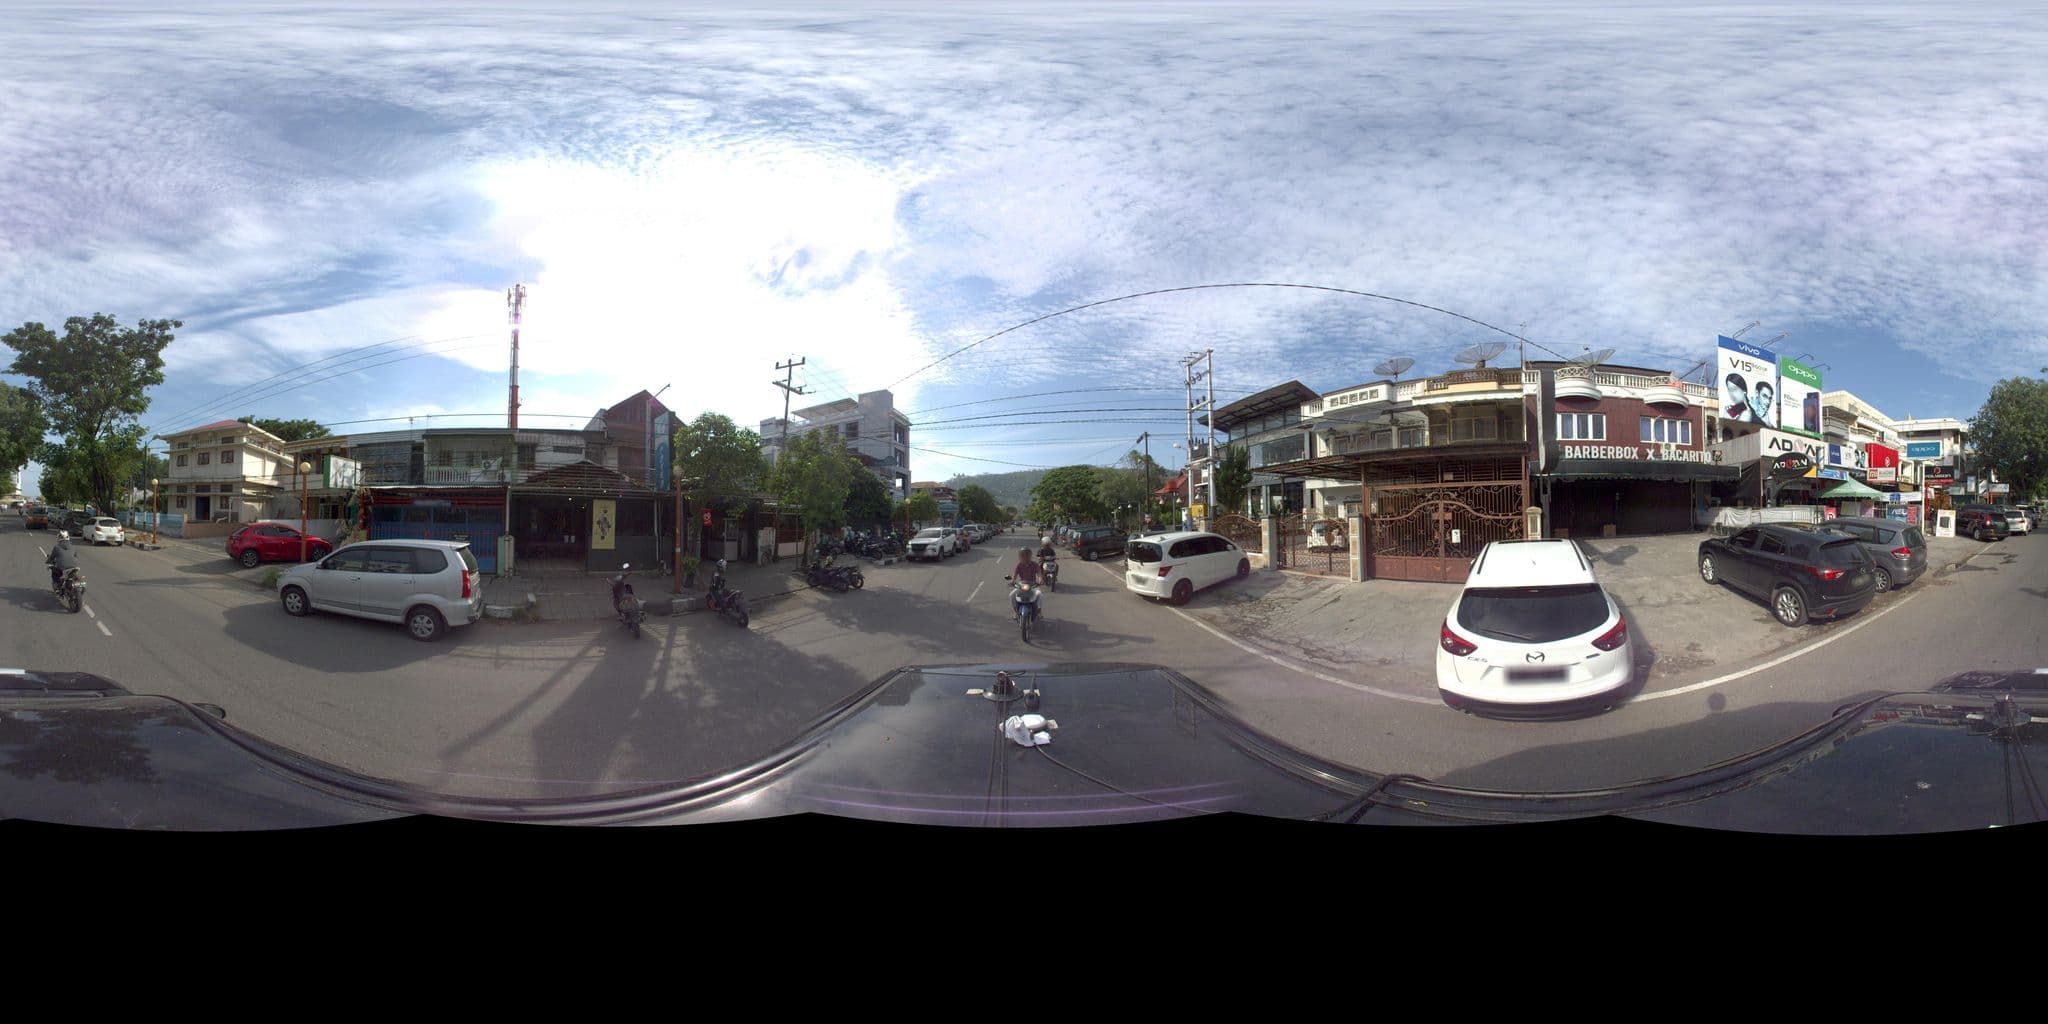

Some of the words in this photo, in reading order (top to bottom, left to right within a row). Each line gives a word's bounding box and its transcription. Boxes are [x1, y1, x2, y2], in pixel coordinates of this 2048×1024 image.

[1738, 344, 1760, 356] vivo
[1729, 356, 1752, 373] V15
[1788, 364, 1817, 380] oppo
[1564, 445, 1639, 460] BARBERBOX
[1661, 449, 1712, 463] BACARITO
[1768, 437, 1816, 457] ADVA
